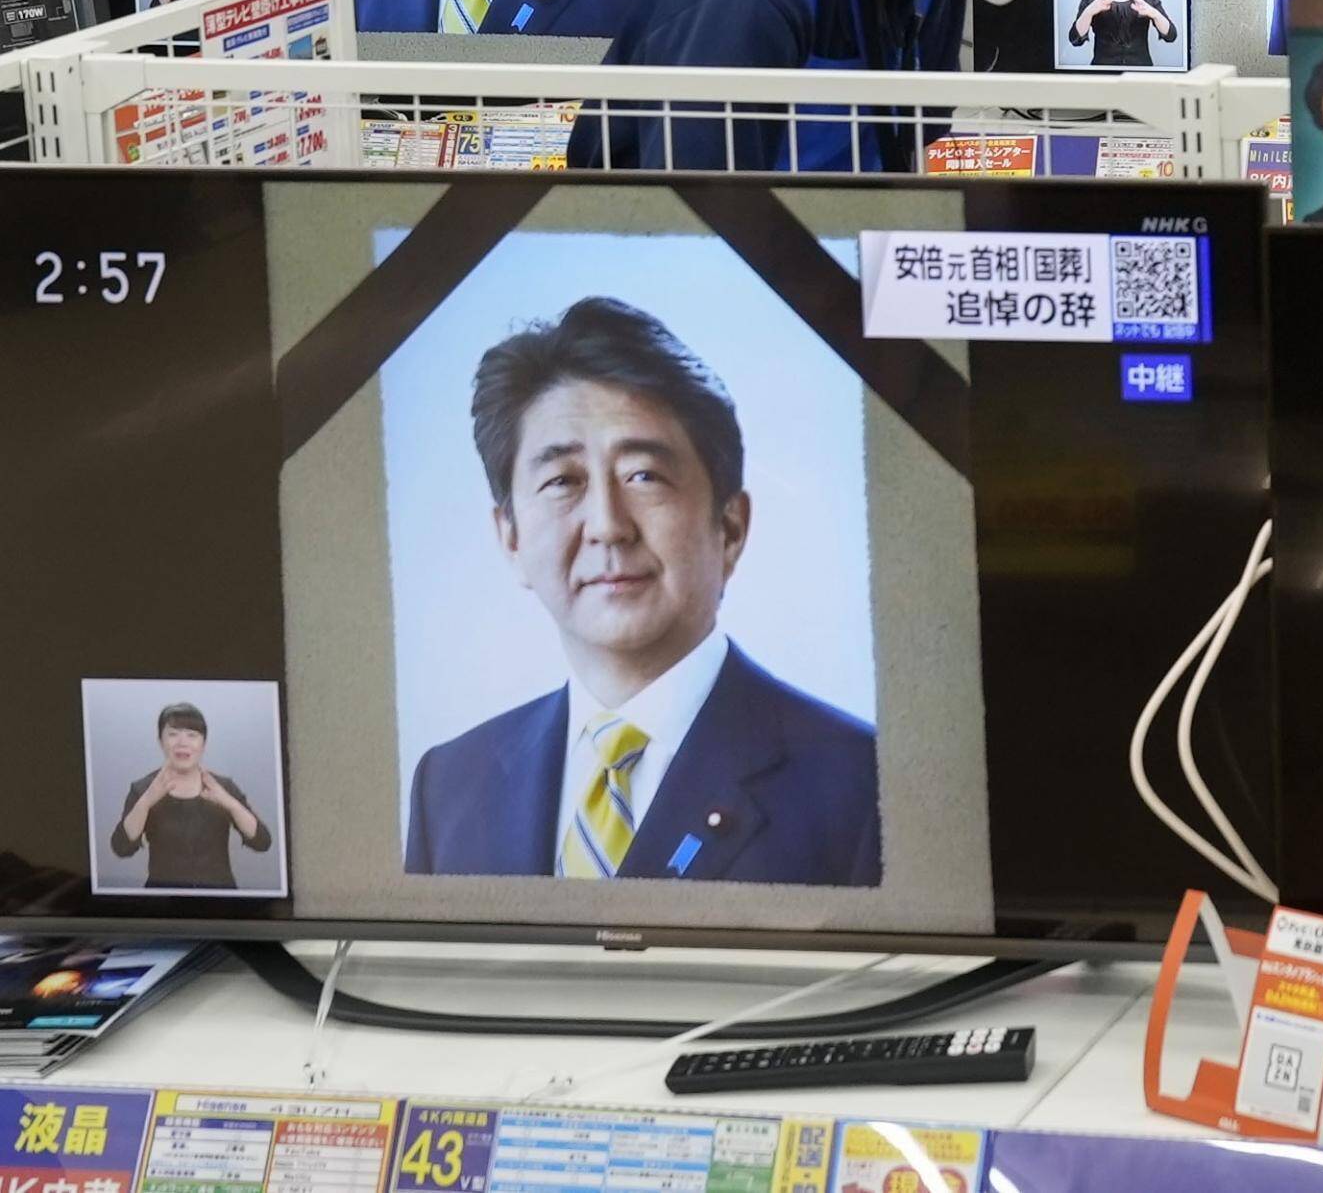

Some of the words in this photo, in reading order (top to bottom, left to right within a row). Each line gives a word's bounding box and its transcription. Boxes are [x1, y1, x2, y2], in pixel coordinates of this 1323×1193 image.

[1141, 217, 1190, 233] NHK
[36, 252, 165, 303] 2:57
[895, 243, 1092, 284] 安倍元首相「国葬」
[946, 291, 1096, 328] 追悼の辞
[1128, 363, 1185, 393] 中継
[14, 1101, 110, 1156] 液晶
